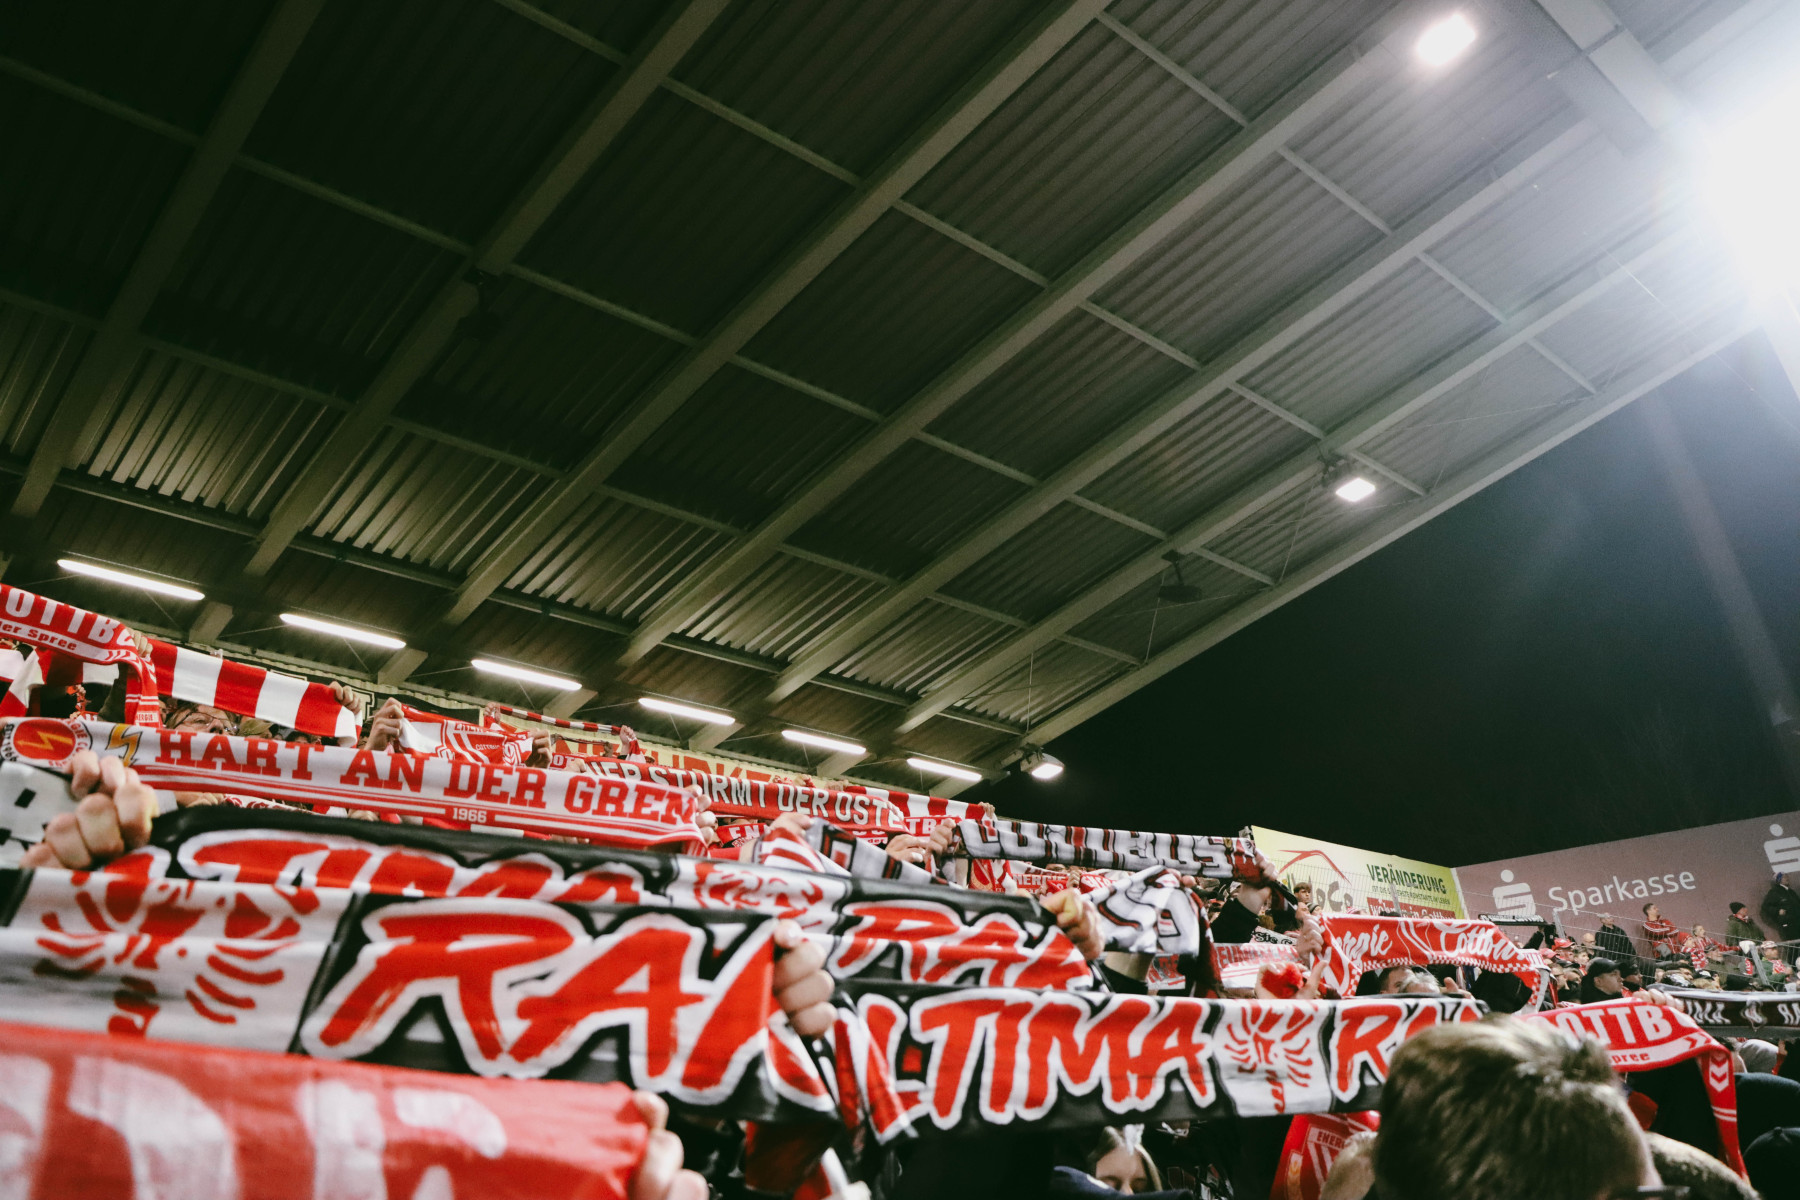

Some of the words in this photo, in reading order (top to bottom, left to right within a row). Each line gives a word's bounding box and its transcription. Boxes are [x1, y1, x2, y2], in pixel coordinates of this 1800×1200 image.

[27, 628, 77, 650] Spree
[155, 728, 324, 781] HART
[340, 752, 430, 793] AN
[443, 760, 547, 809] DER
[452, 807, 487, 823] 1966
[777, 783, 829, 818] DER
[1366, 863, 1447, 894] VERÄNDERUNG
[1548, 871, 1697, 916] Sparkasse
[1610, 1052, 1650, 1064] pree
